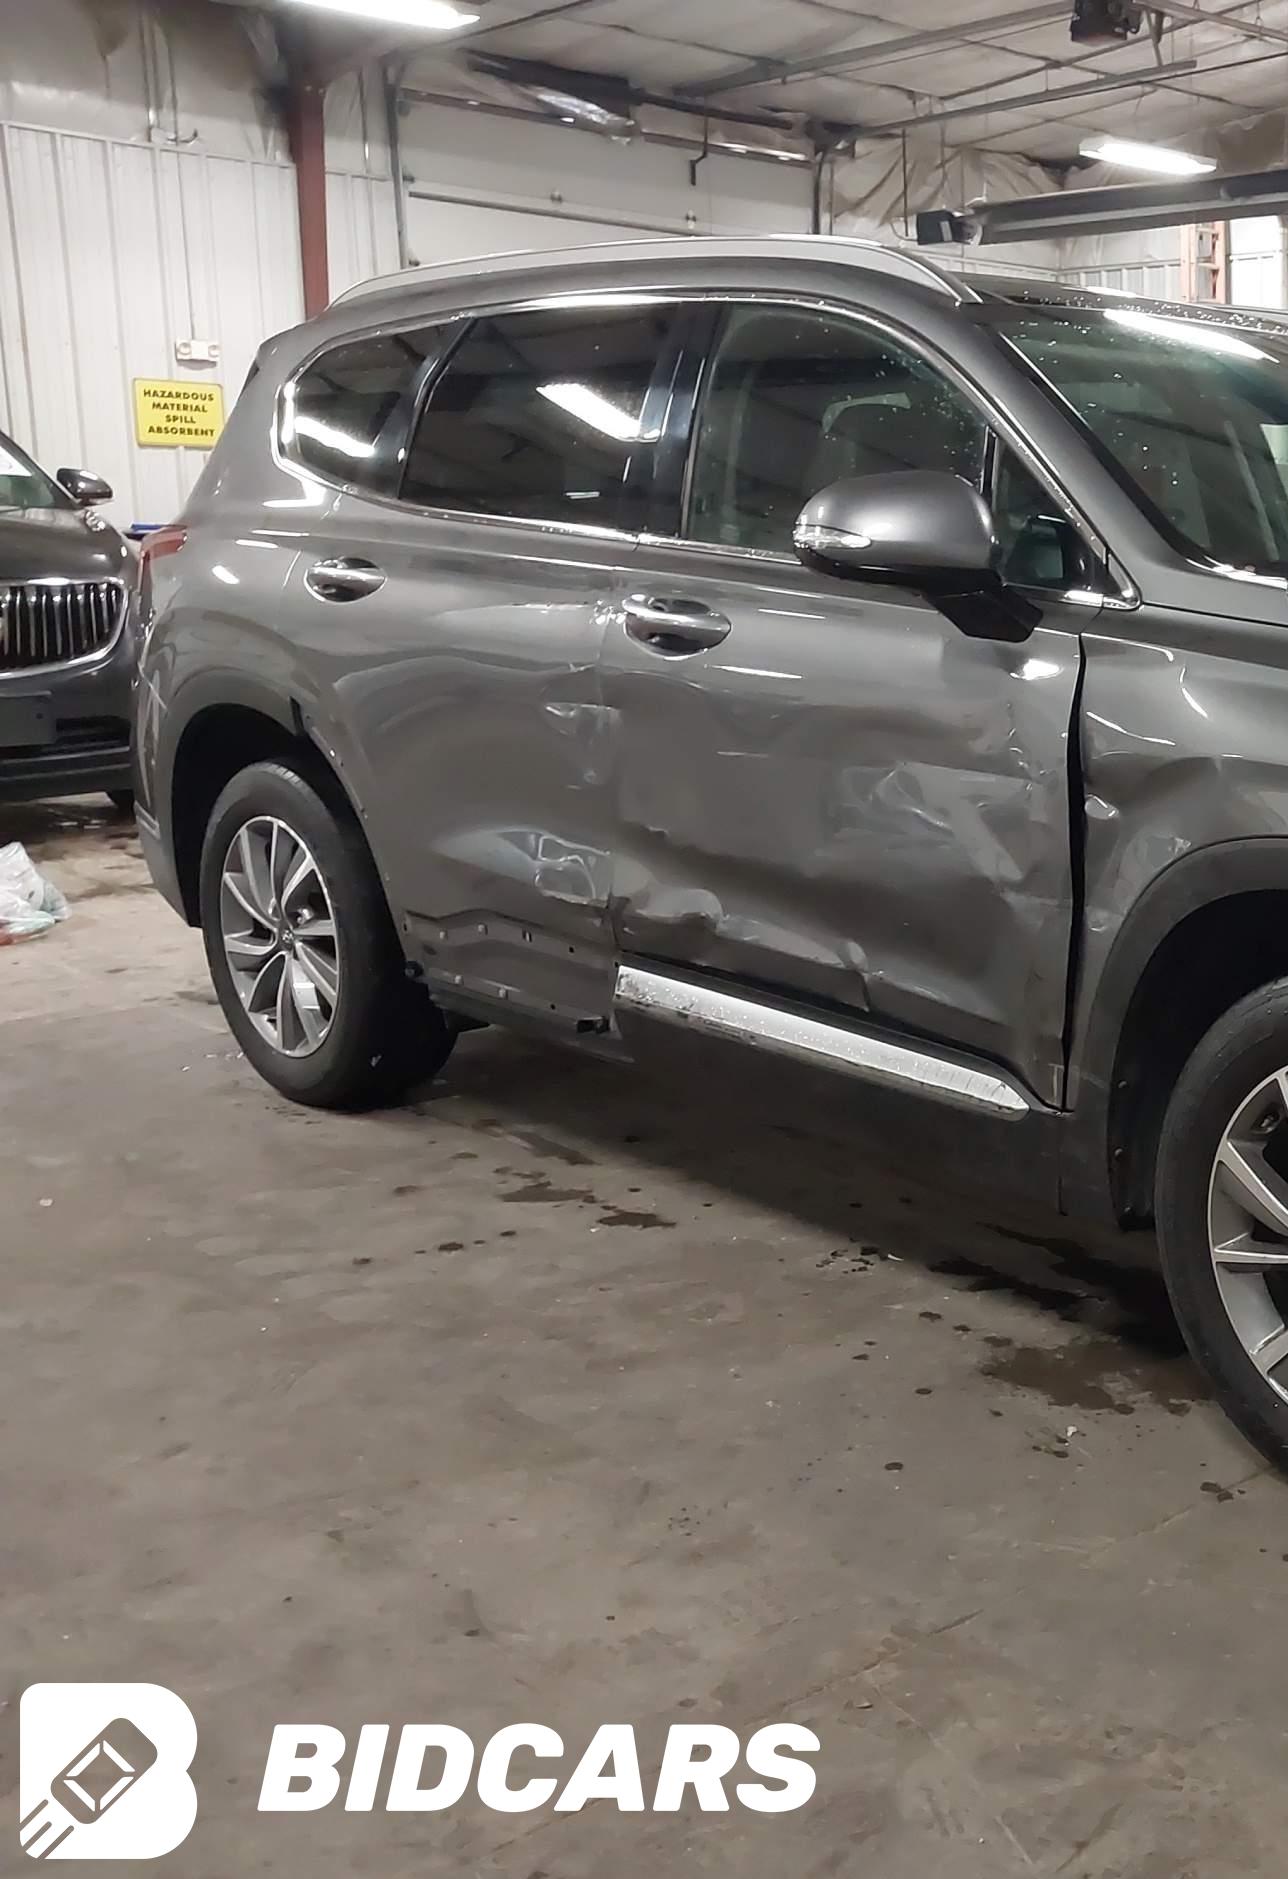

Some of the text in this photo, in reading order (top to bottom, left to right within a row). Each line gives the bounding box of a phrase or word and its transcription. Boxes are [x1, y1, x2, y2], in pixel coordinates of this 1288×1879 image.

[143, 389, 214, 402] HAZARDOUS
[152, 402, 208, 413] MATERIAL
[165, 414, 196, 424] SPILL
[148, 425, 215, 437] ABSORBENT
